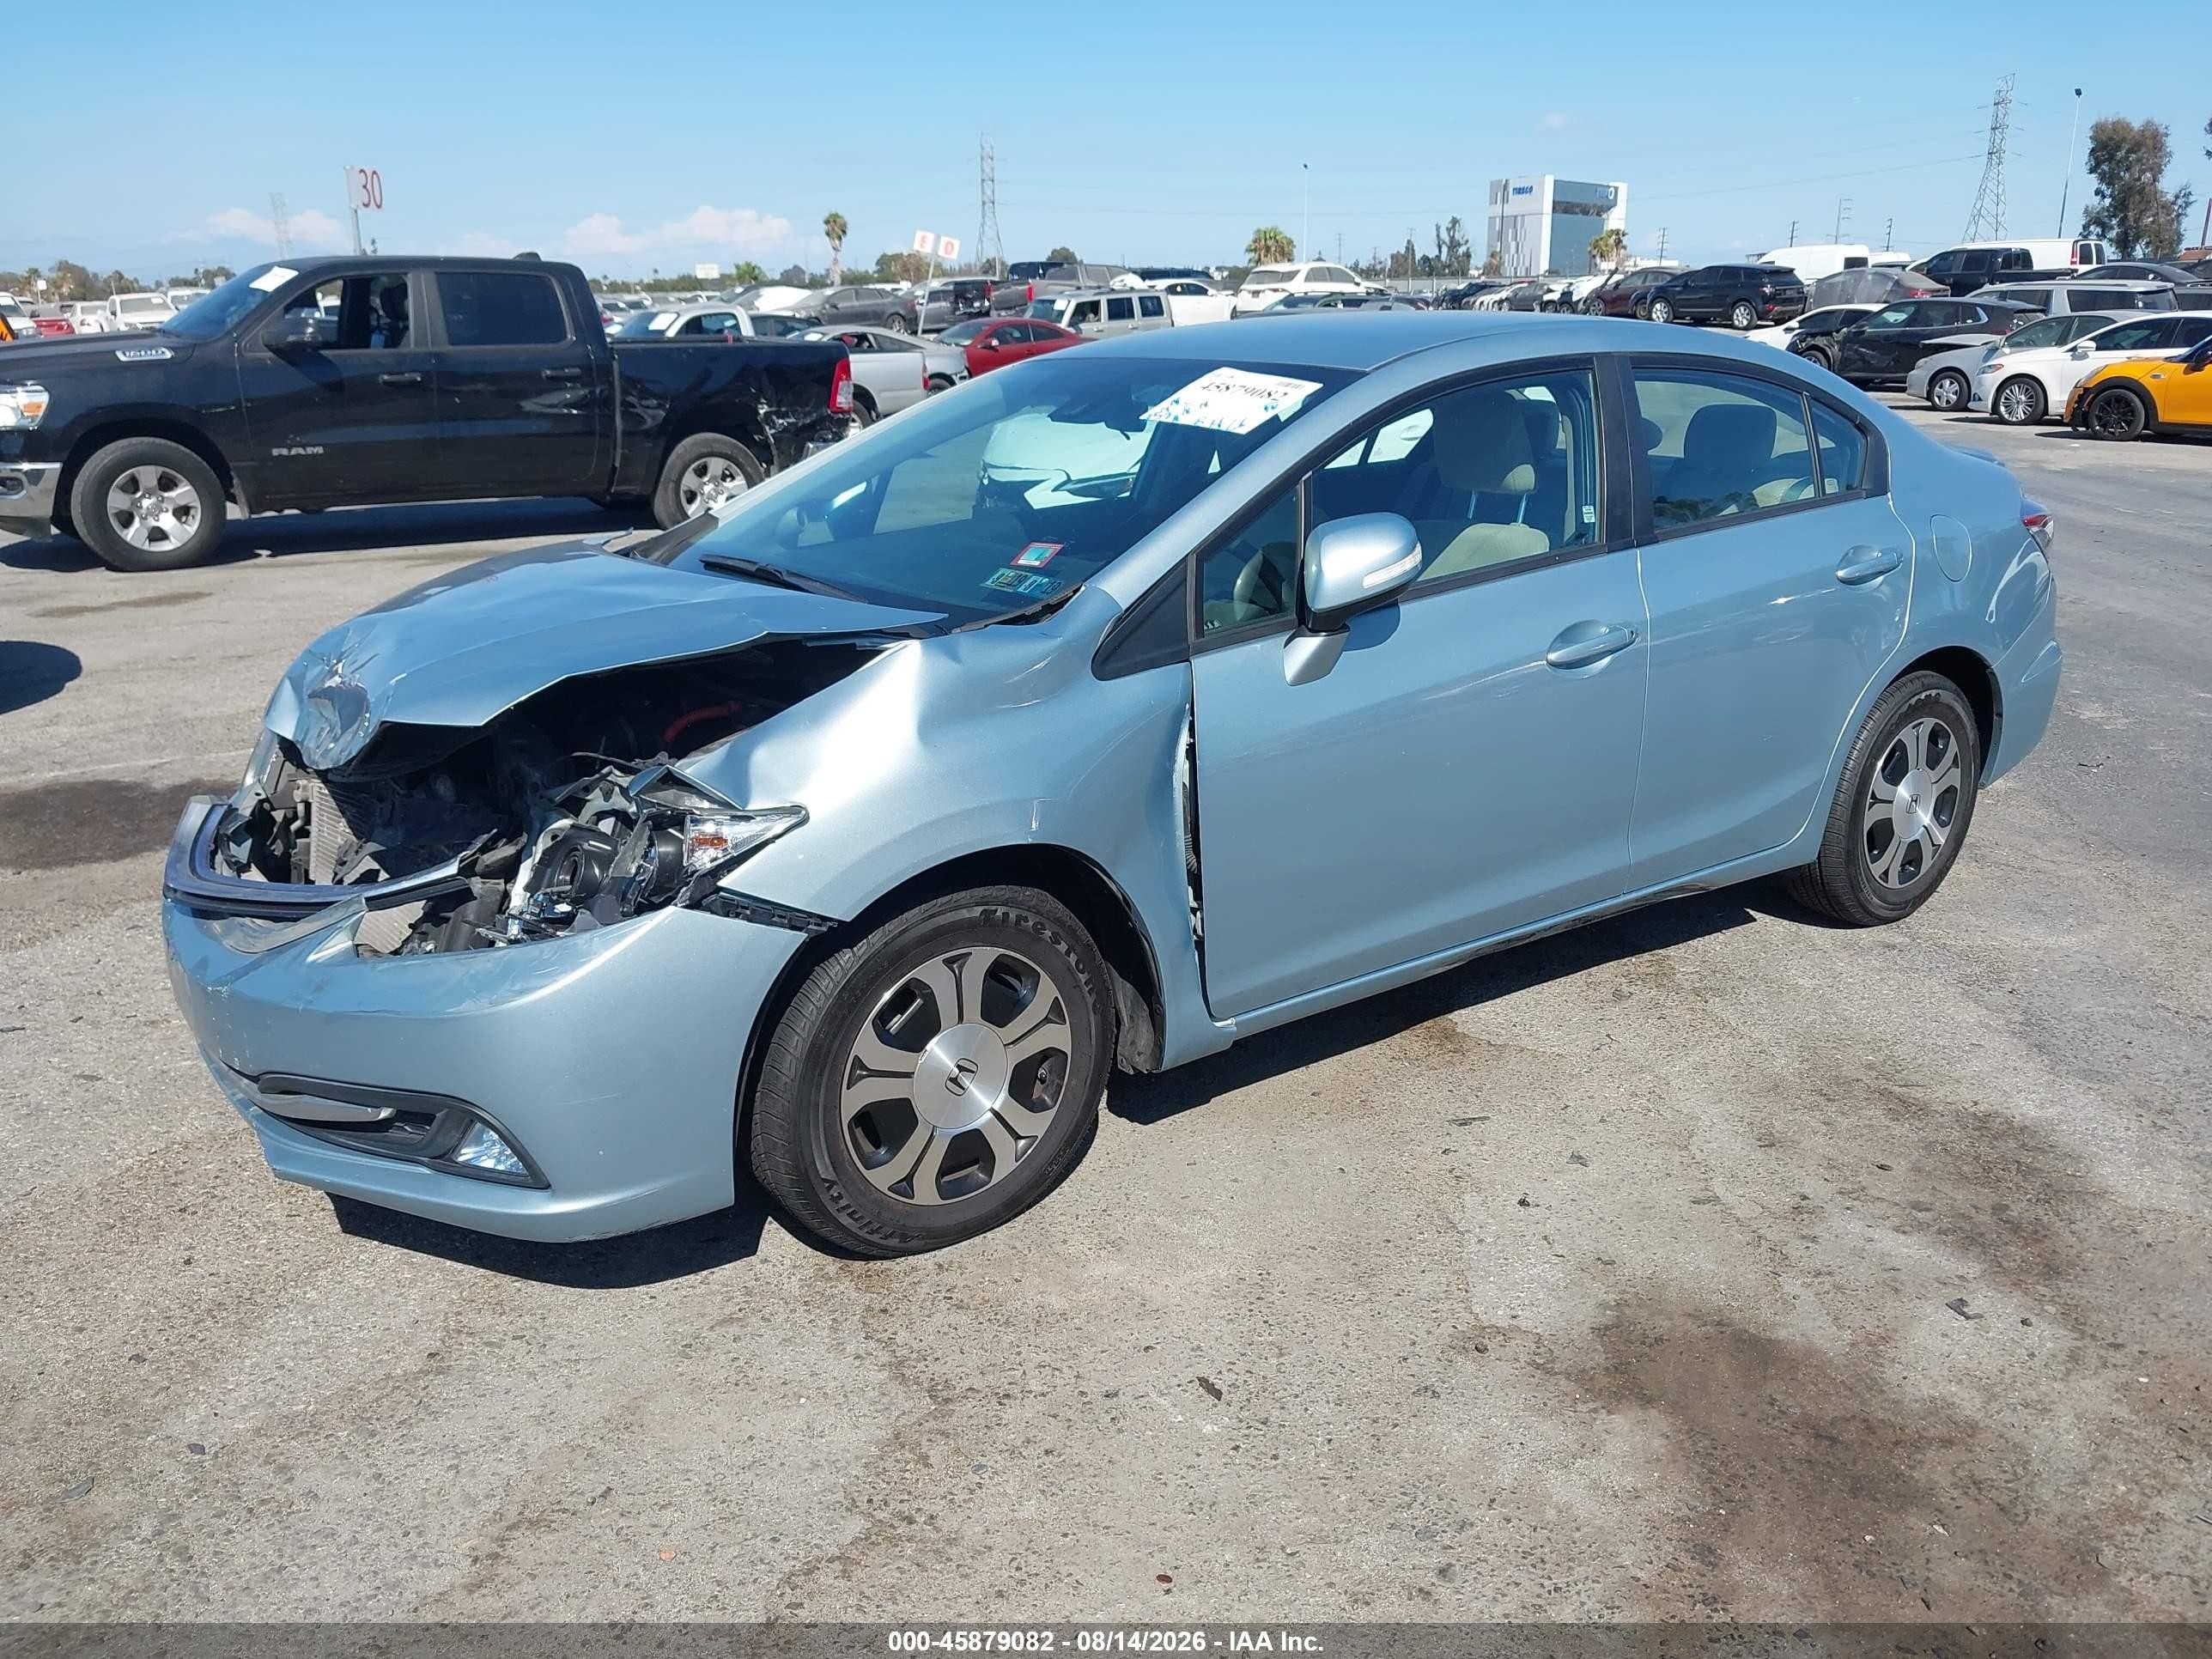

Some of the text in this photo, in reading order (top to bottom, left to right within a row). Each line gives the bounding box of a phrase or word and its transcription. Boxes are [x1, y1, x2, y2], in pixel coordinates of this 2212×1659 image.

[358, 168, 383, 209] 30
[1200, 381, 1289, 402] 45879082
[271, 446, 325, 457] RAM
[979, 908, 1103, 1016] Firestone
